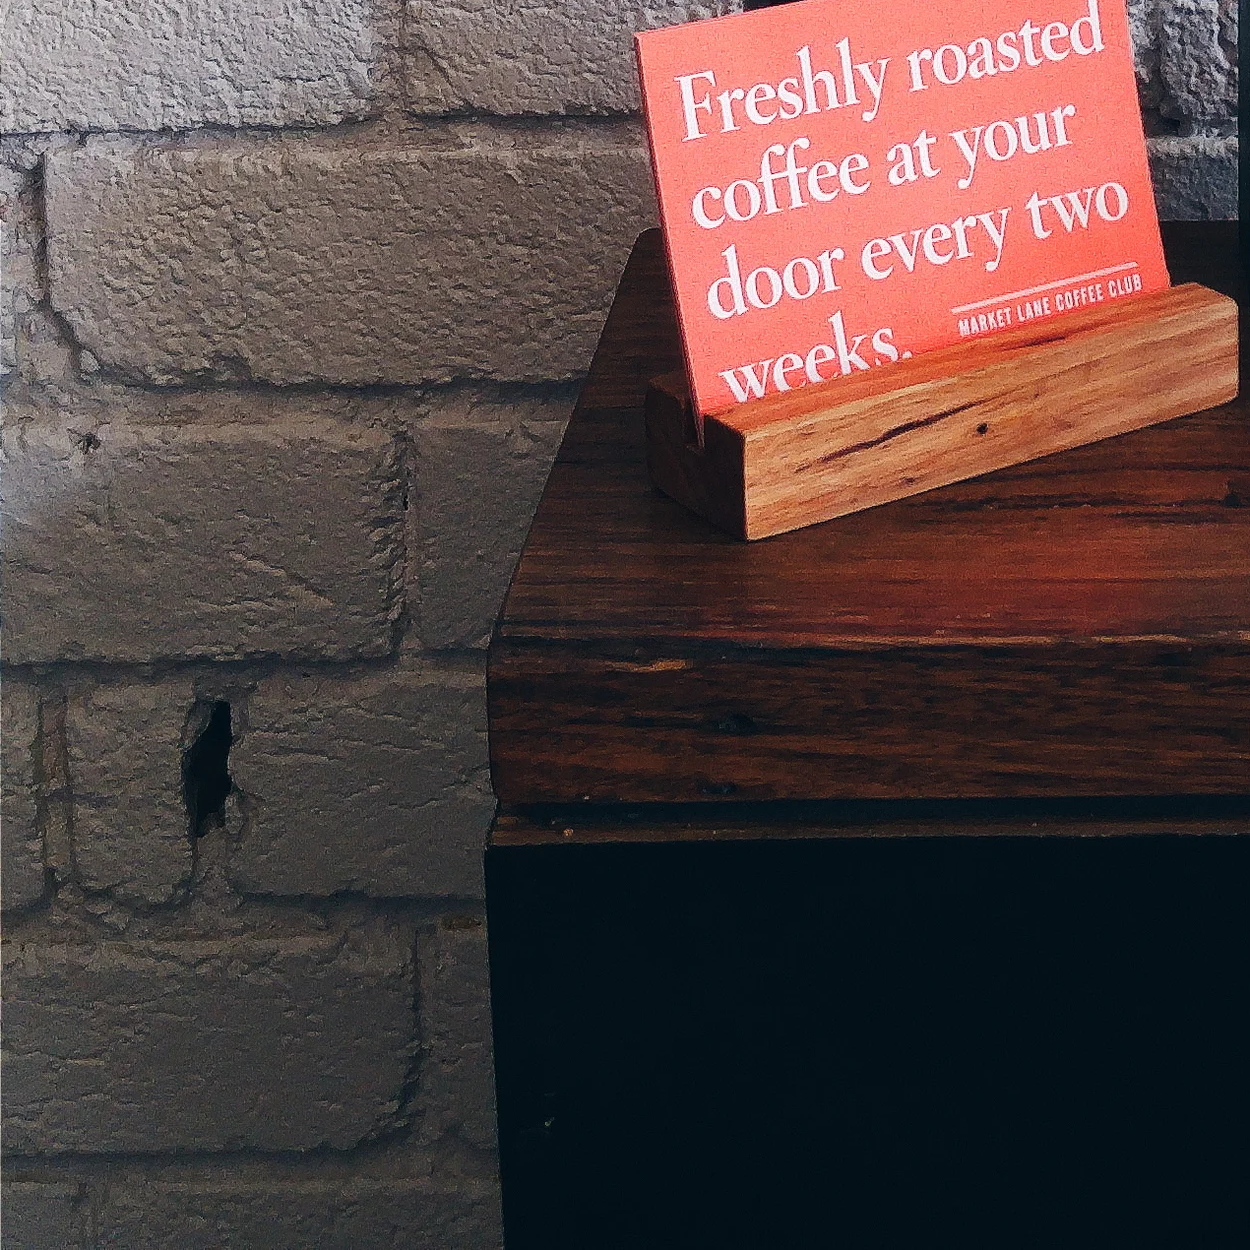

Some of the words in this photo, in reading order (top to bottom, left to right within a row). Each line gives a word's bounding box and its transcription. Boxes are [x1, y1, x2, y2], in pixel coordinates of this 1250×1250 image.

[673, 36, 892, 143] Freshly
[691, 137, 872, 230] coffee
[885, 129, 942, 187] at
[947, 104, 1076, 190] your
[707, 243, 845, 320] door
[861, 206, 1012, 280] every
[1024, 181, 1129, 240] two
[717, 309, 913, 403] weeks.
[958, 306, 1012, 337] MARKET
[1016, 296, 1052, 323] LANE
[1055, 283, 1104, 311] COFFEE
[1107, 274, 1142, 298] CLUB
